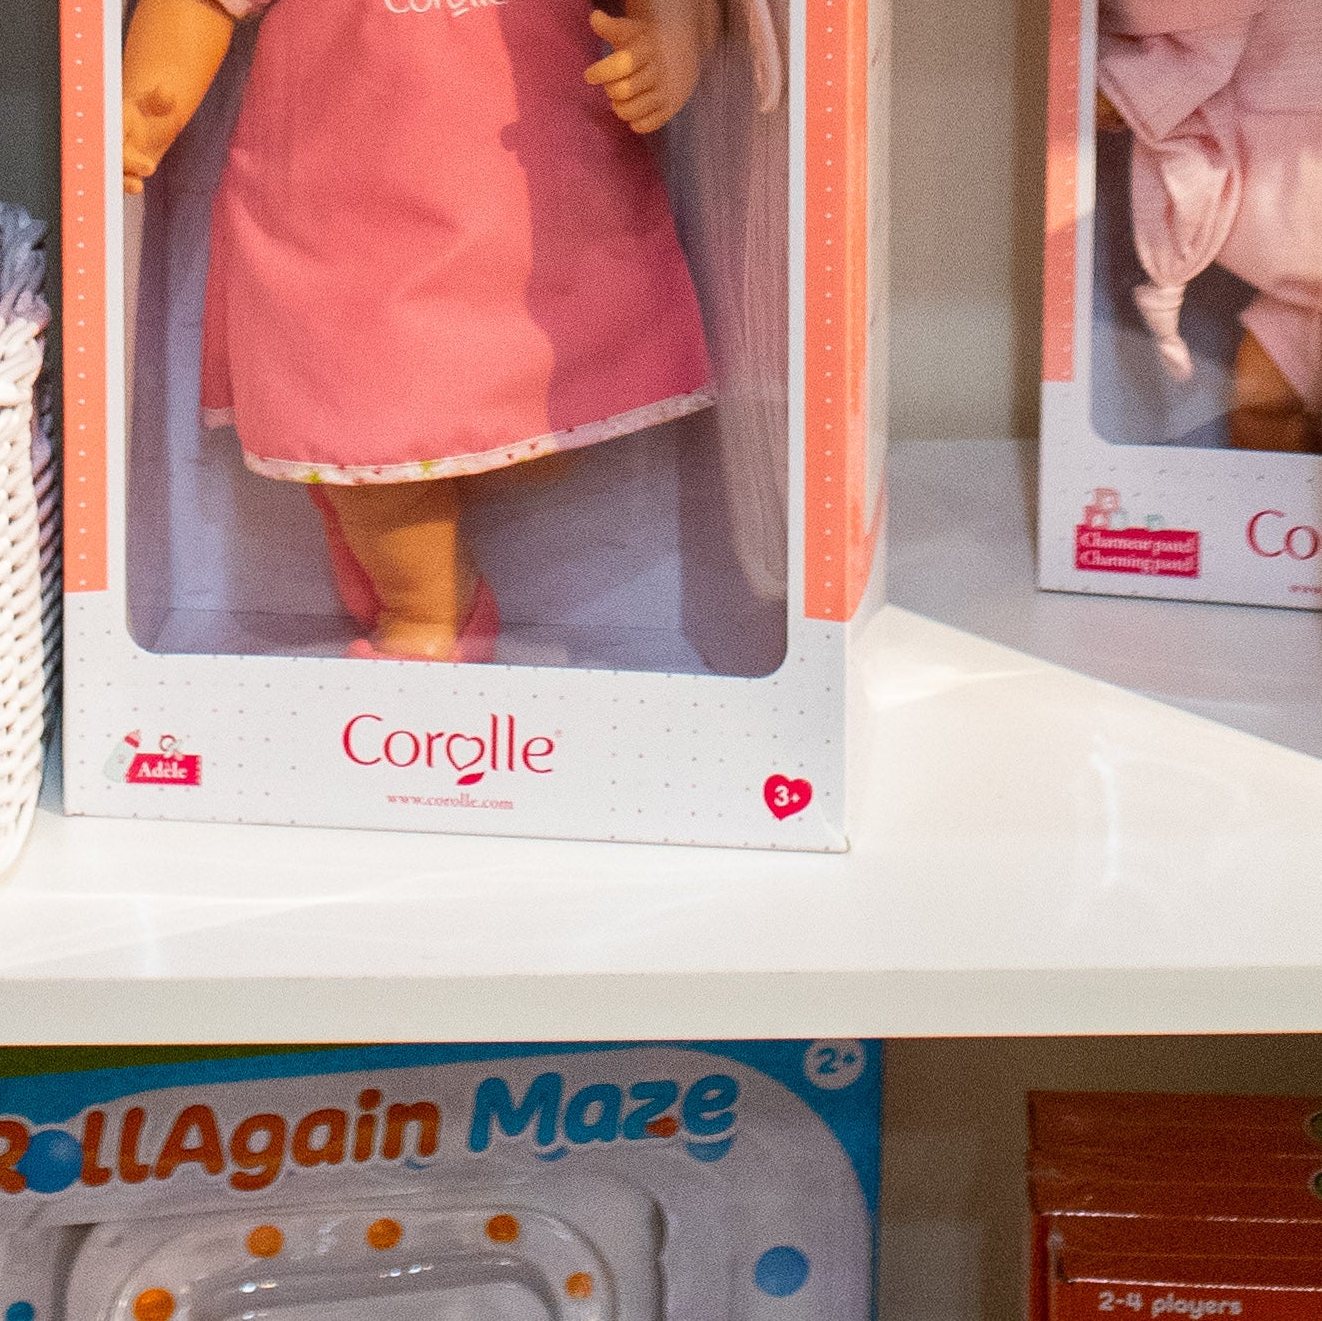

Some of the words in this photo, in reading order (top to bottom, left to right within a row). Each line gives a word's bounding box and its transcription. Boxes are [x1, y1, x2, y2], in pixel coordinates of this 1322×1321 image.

[343, 714, 555, 786] Corolle
[138, 759, 187, 781] Adèle
[387, 791, 514, 810] www.corolle.com
[815, 1048, 855, 1076] 2+
[468, 1073, 739, 1154] Maze
[1098, 1292, 1145, 1314] 2-4
[1152, 1293, 1243, 1321] players
